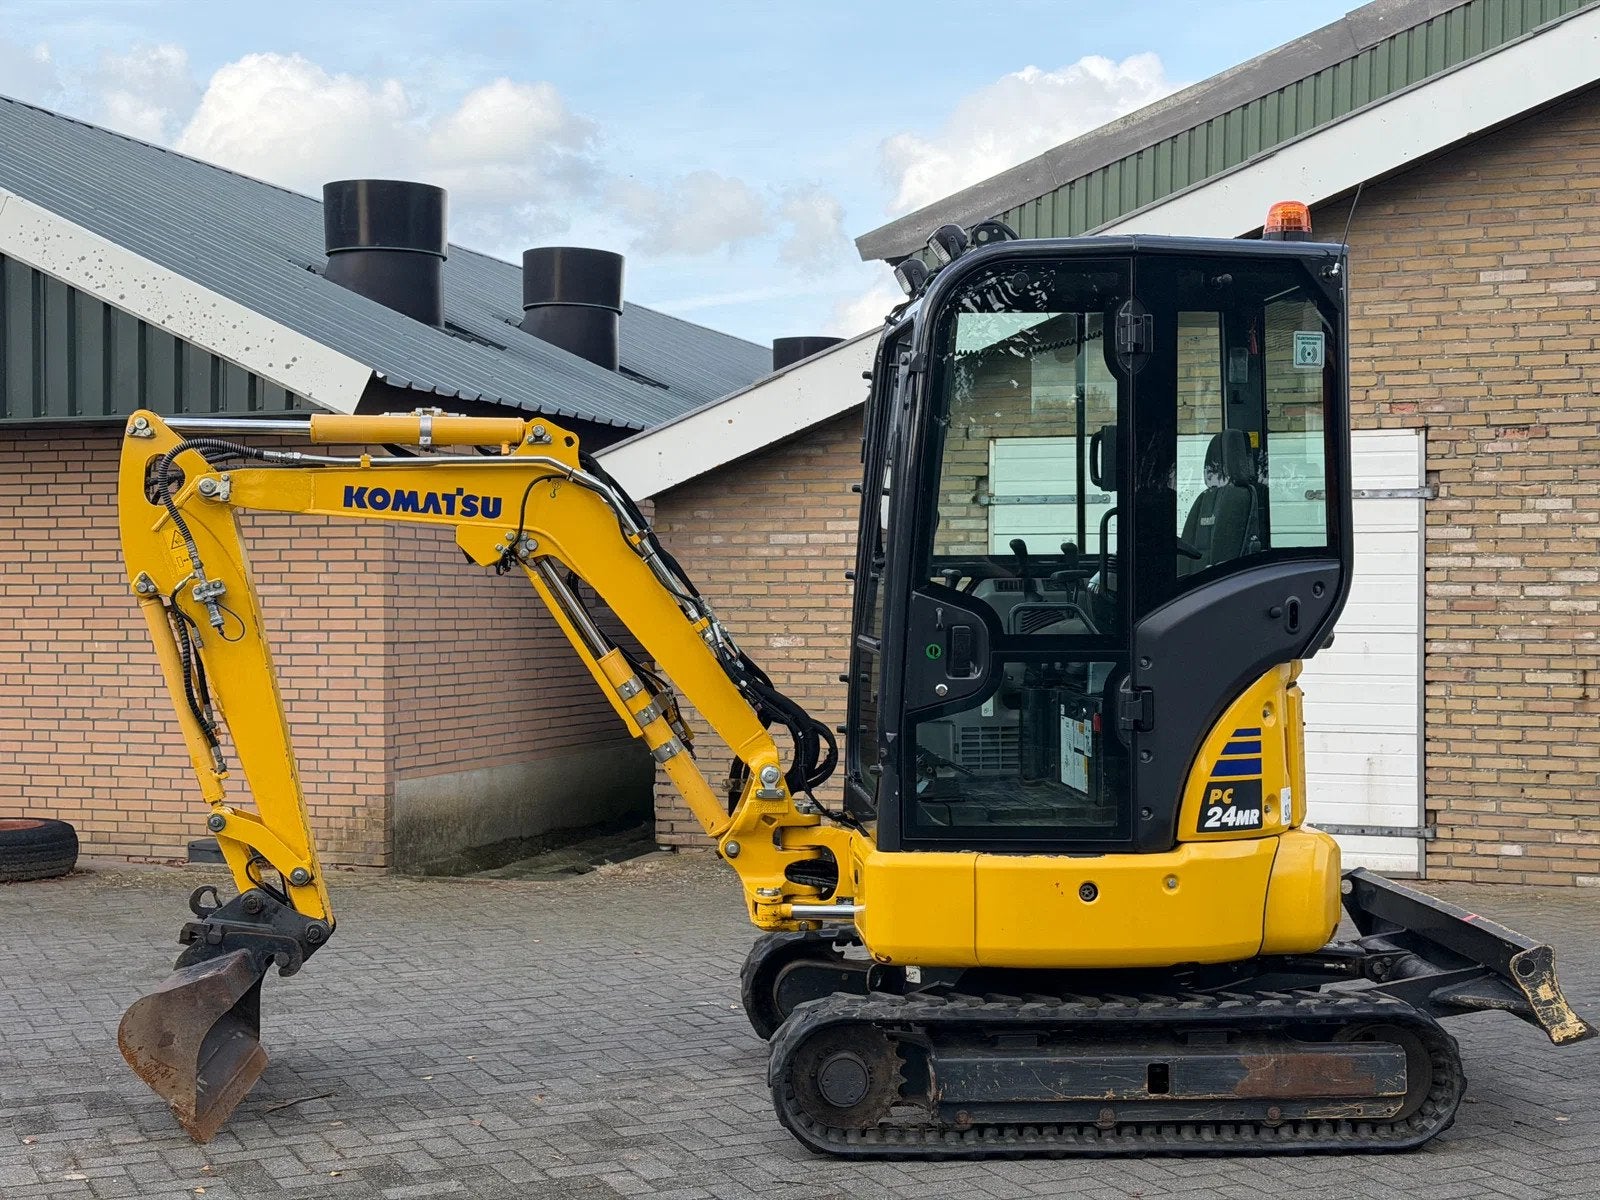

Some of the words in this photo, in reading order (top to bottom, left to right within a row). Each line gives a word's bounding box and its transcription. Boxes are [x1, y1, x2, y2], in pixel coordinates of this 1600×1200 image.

[343, 485, 502, 519] KOMATSU
[1209, 788, 1233, 805] PC
[1204, 806, 1260, 828] 24MR
